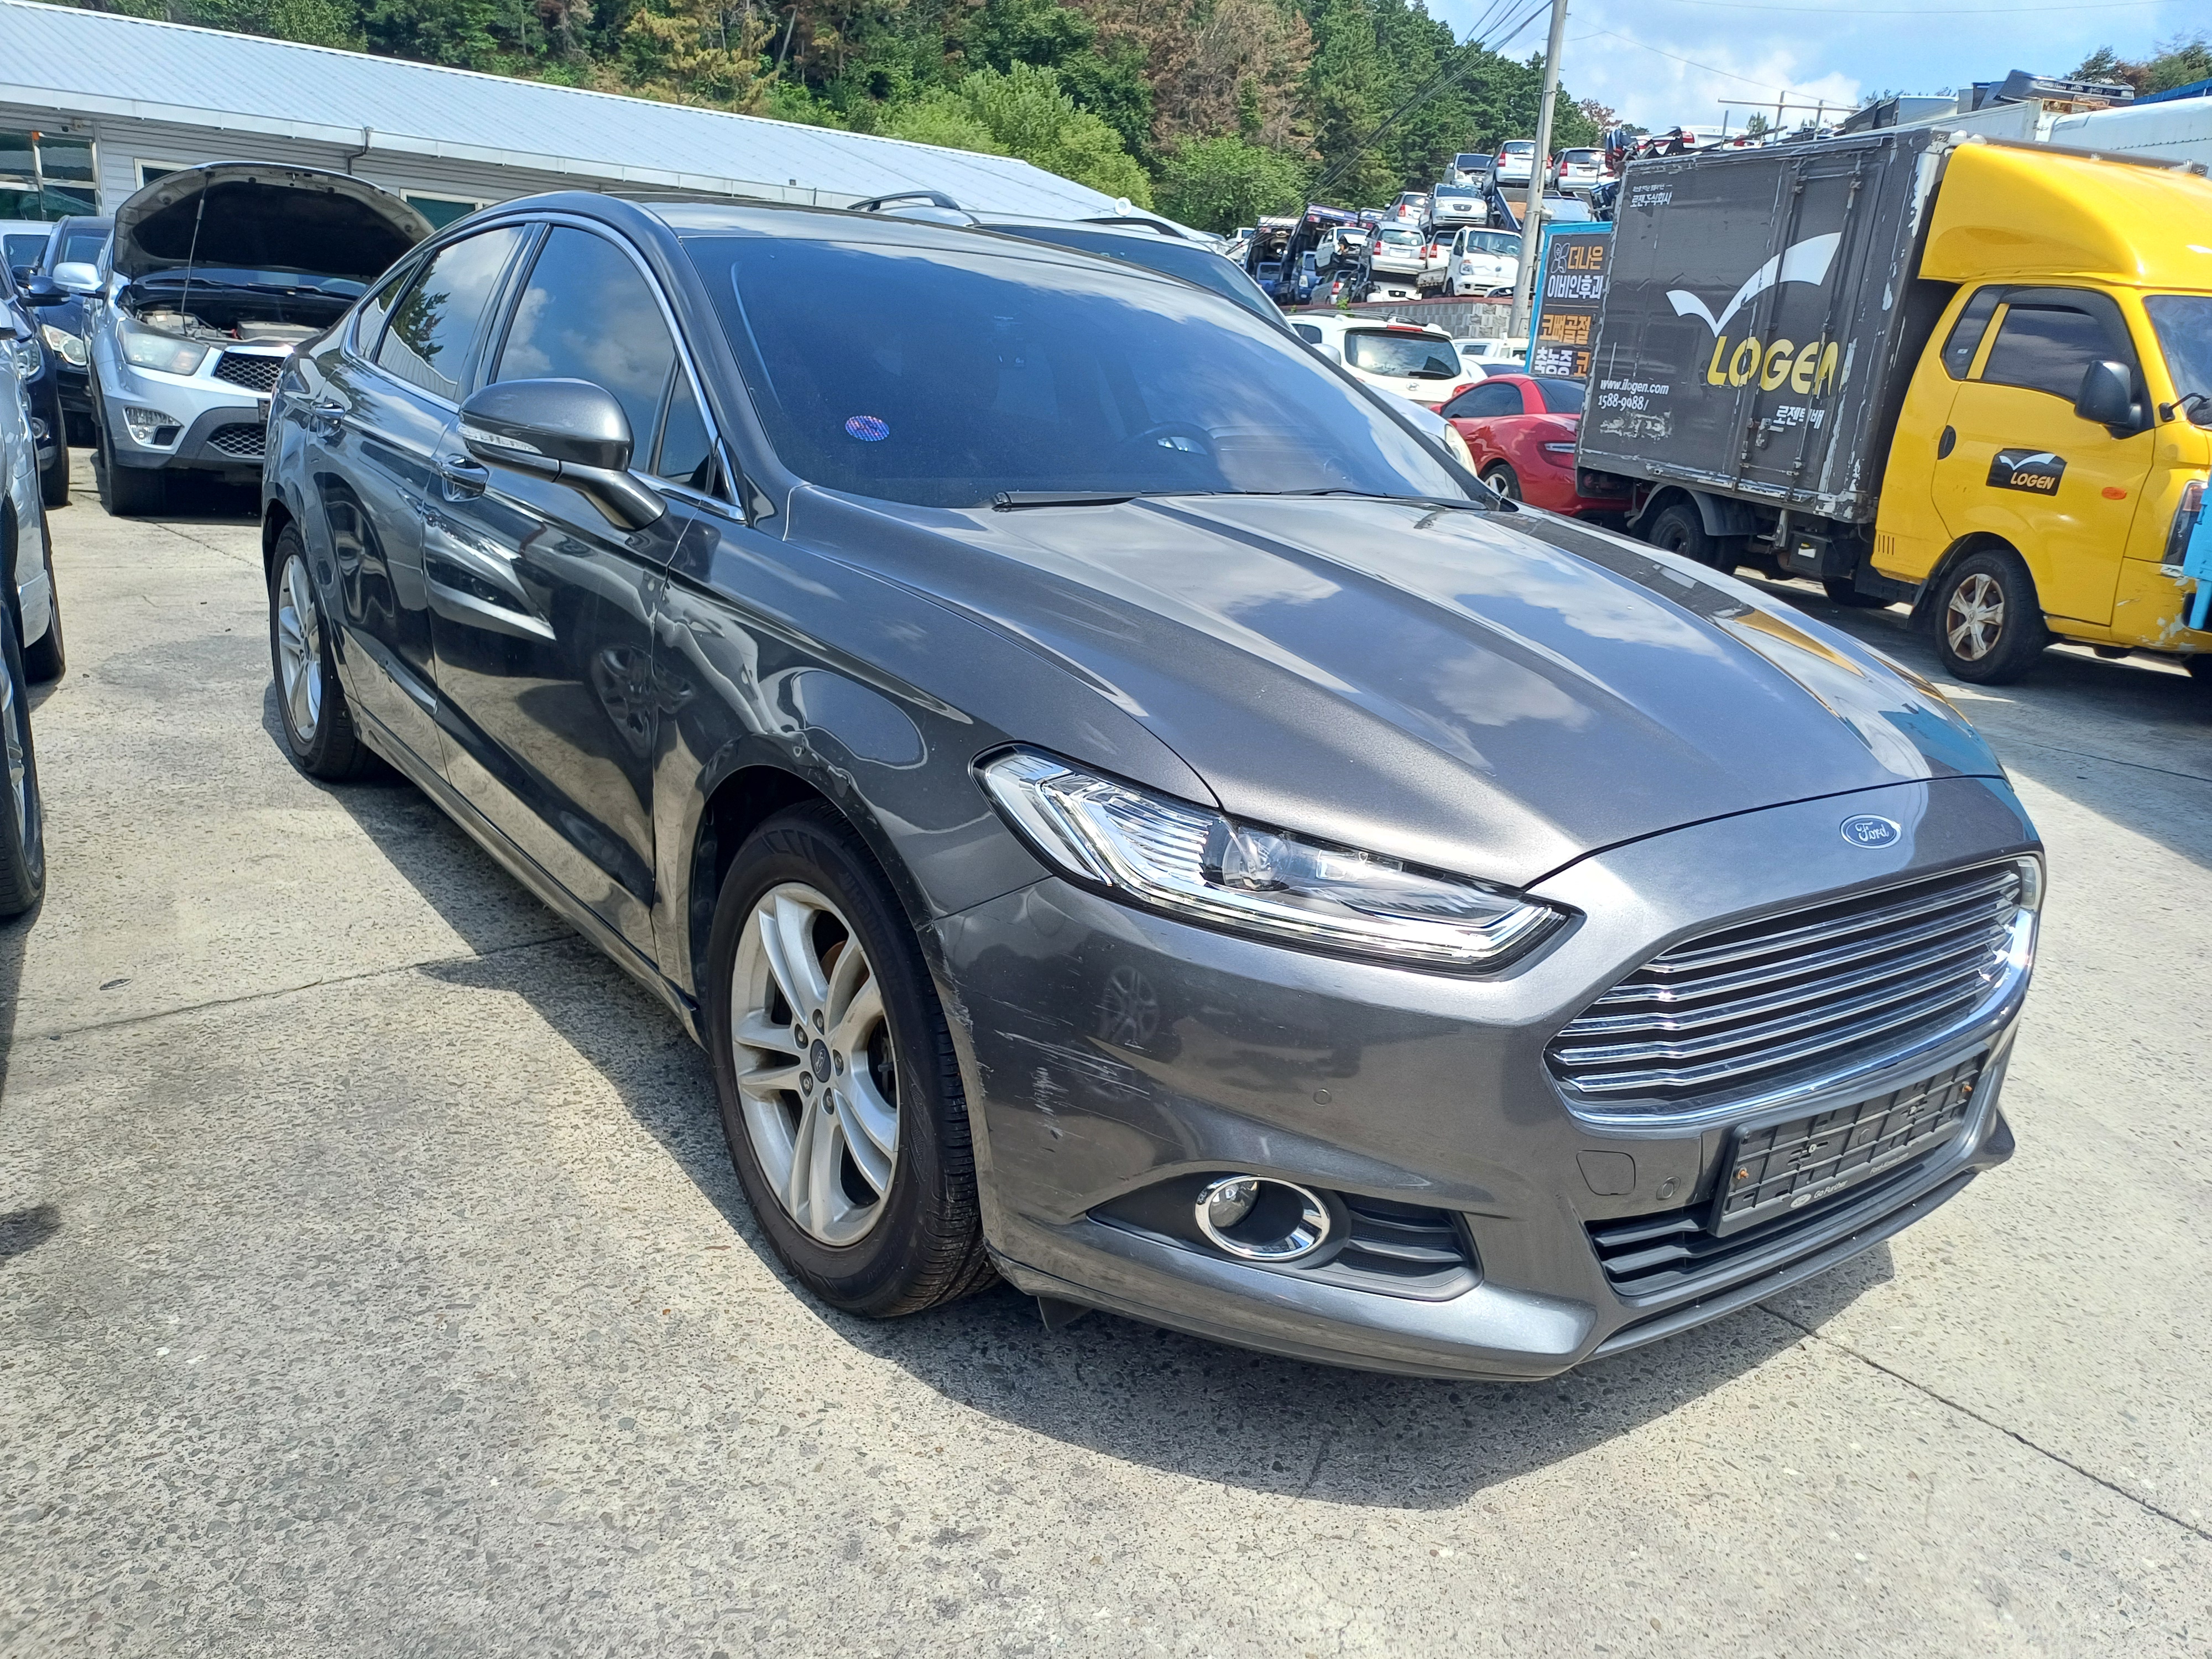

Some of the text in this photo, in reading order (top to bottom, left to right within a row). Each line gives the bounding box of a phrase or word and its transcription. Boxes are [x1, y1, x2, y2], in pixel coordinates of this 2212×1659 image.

[1568, 246, 1603, 270] 더나은
[1547, 275, 1604, 299] 이비인후과
[1539, 314, 1591, 345] 코뼈골절
[1535, 347, 1573, 375] 축농증
[1707, 336, 1838, 396] LOGEN
[1600, 378, 1669, 395] www.ilogen.com
[2010, 472, 2056, 489] LOGEN
[1855, 821, 1890, 842] Ford
[1814, 1190, 1824, 1199] Go
